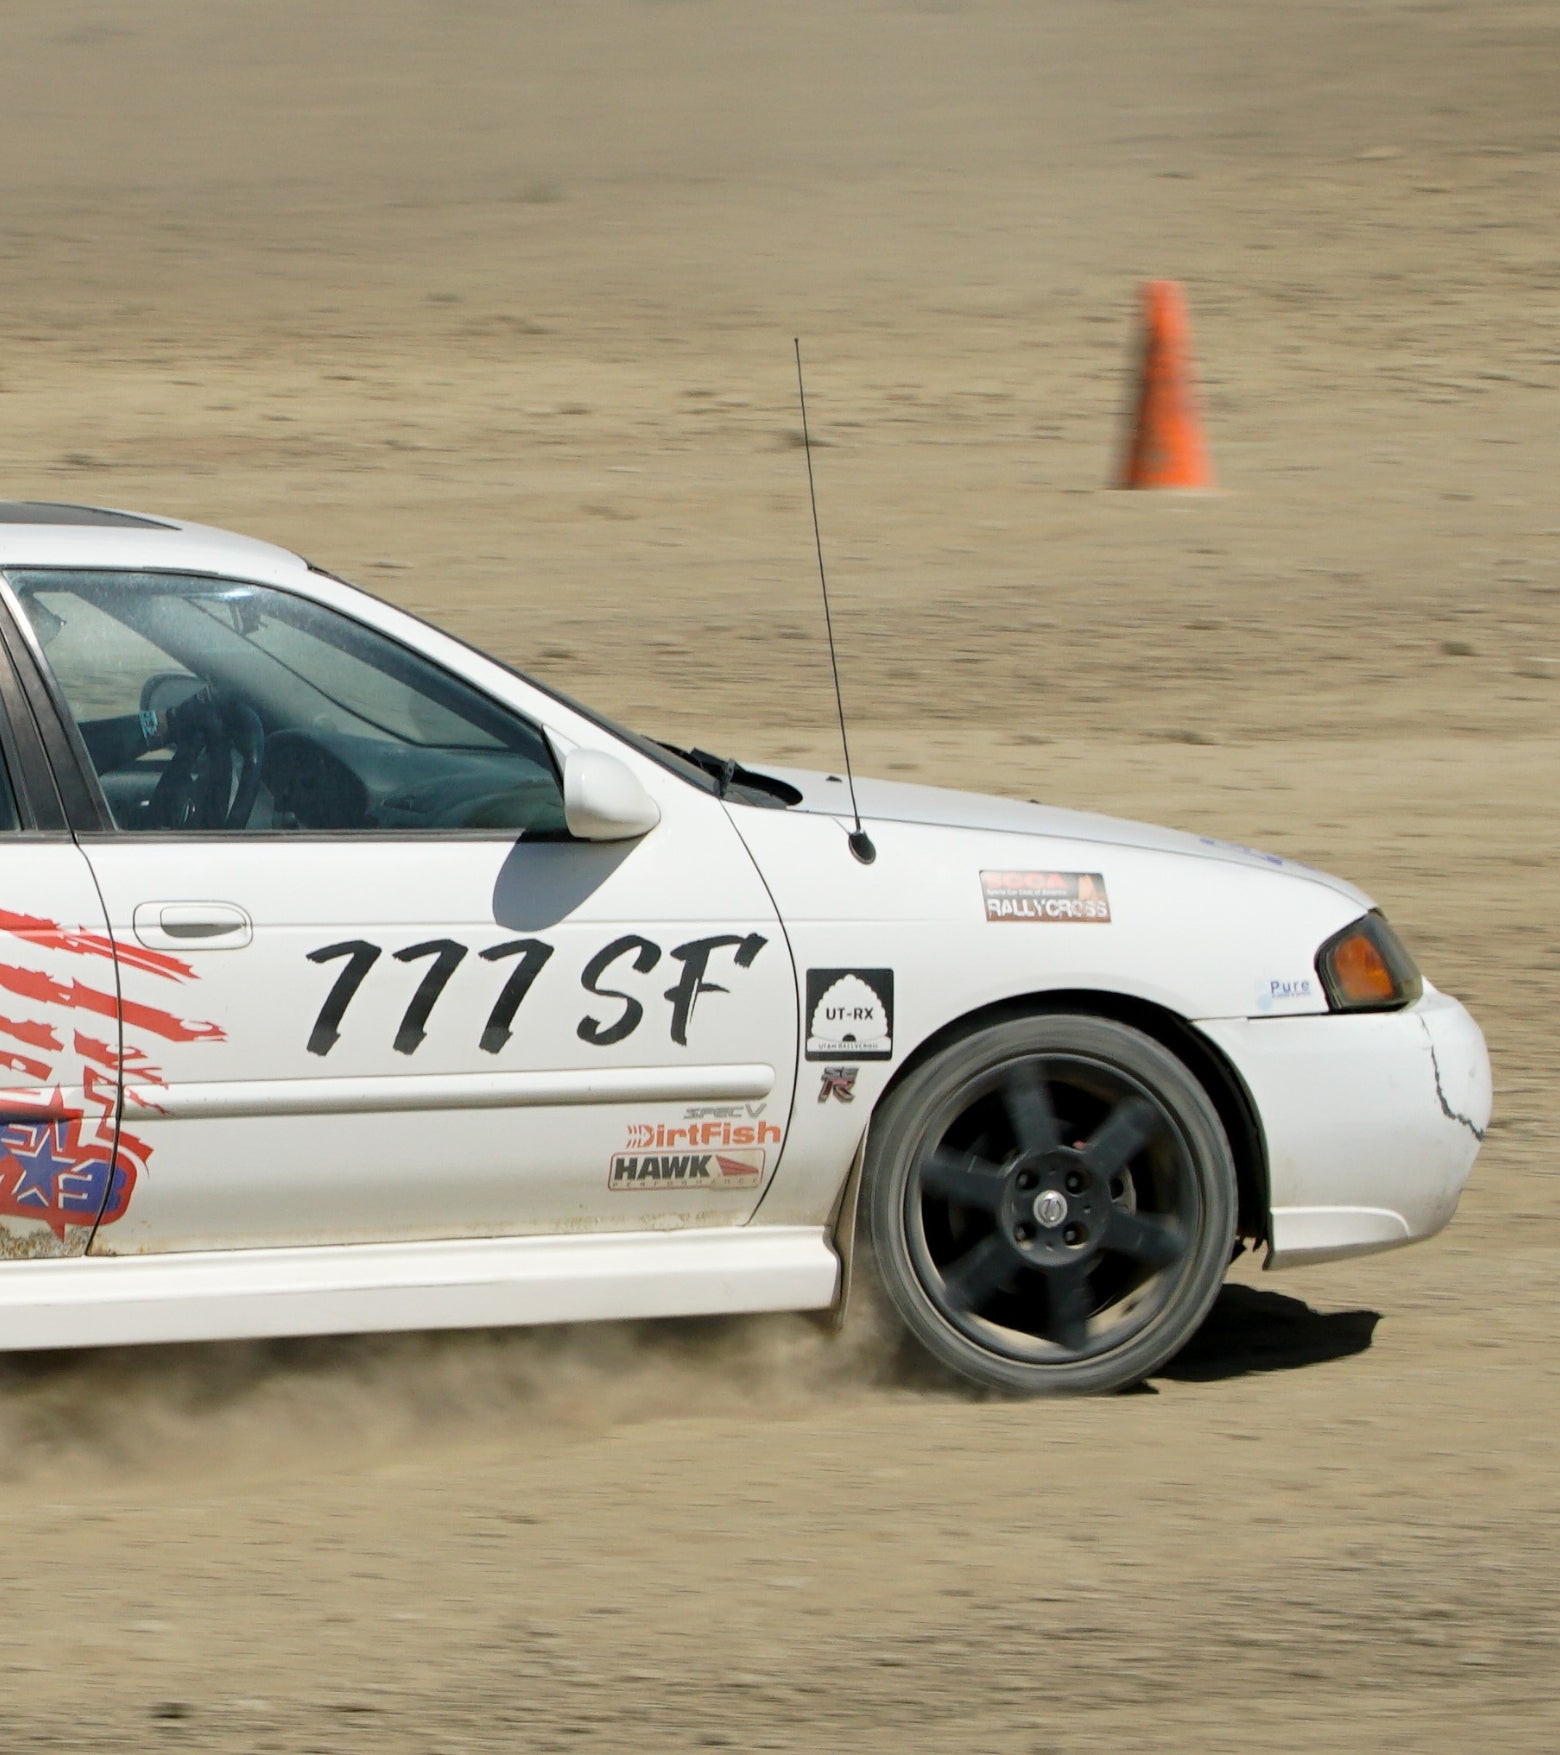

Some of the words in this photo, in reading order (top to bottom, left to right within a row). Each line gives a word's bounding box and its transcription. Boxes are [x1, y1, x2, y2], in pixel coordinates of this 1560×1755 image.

[988, 898, 1109, 918] RALLYCROSS
[577, 933, 769, 1047] SF
[1270, 980, 1309, 994] Pure
[826, 1008, 874, 1020] UT-RX
[626, 1120, 781, 1149] DirtFish
[614, 1154, 713, 1181] HAWK
